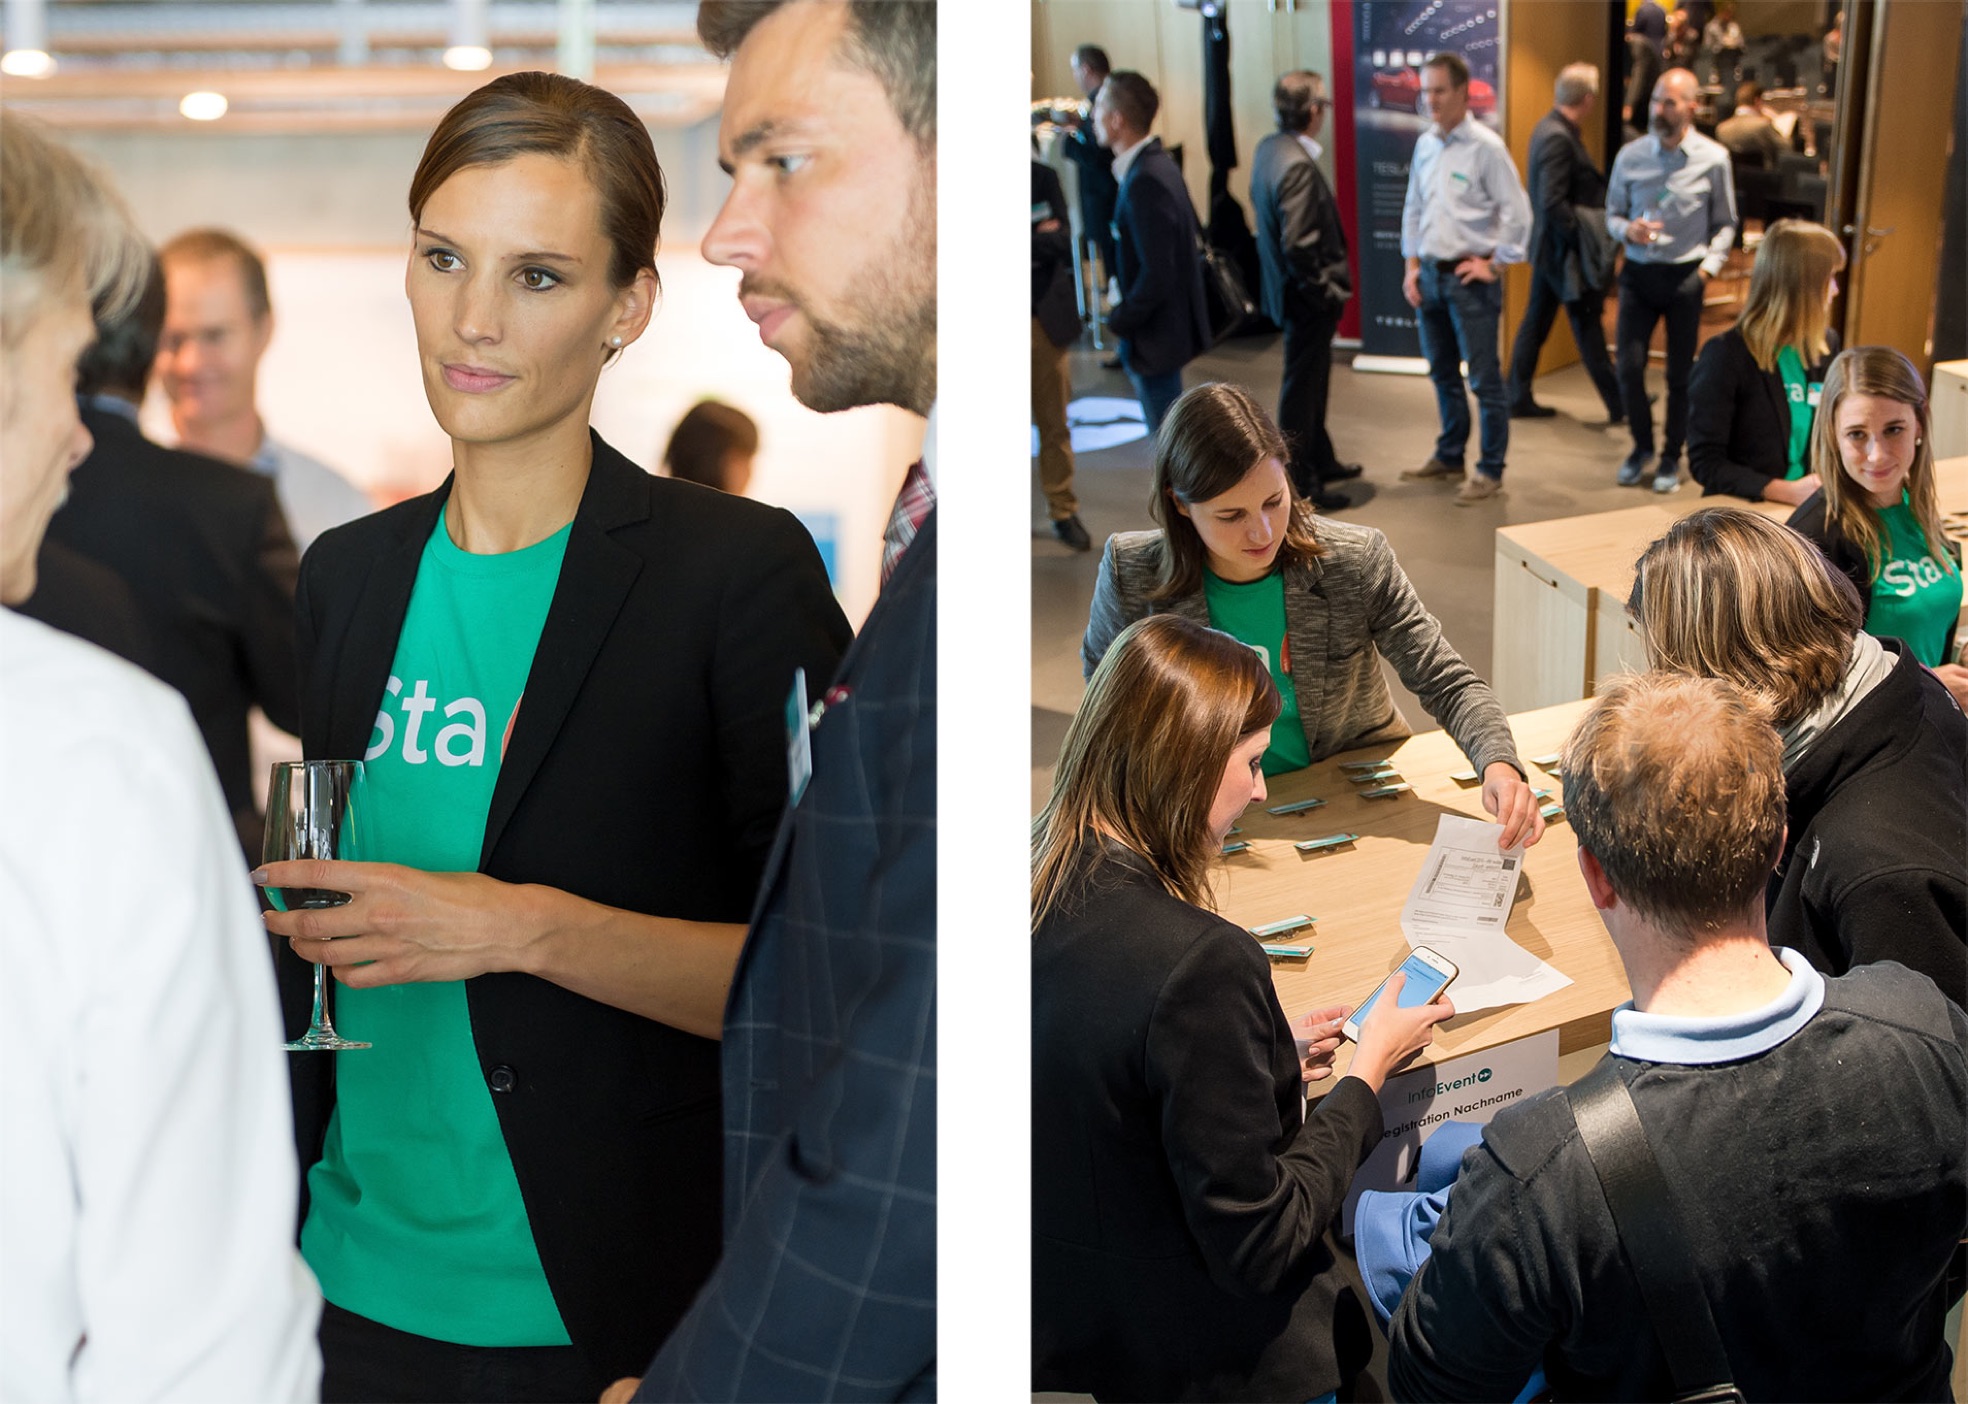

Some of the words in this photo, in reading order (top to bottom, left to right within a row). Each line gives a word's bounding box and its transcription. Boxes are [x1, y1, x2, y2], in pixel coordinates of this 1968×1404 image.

[1882, 556, 1943, 597] Sta
[1407, 1072, 1476, 1104] InfoEvent
[1381, 1111, 1450, 1138] egistration
[1453, 1088, 1523, 1116] Nachname
